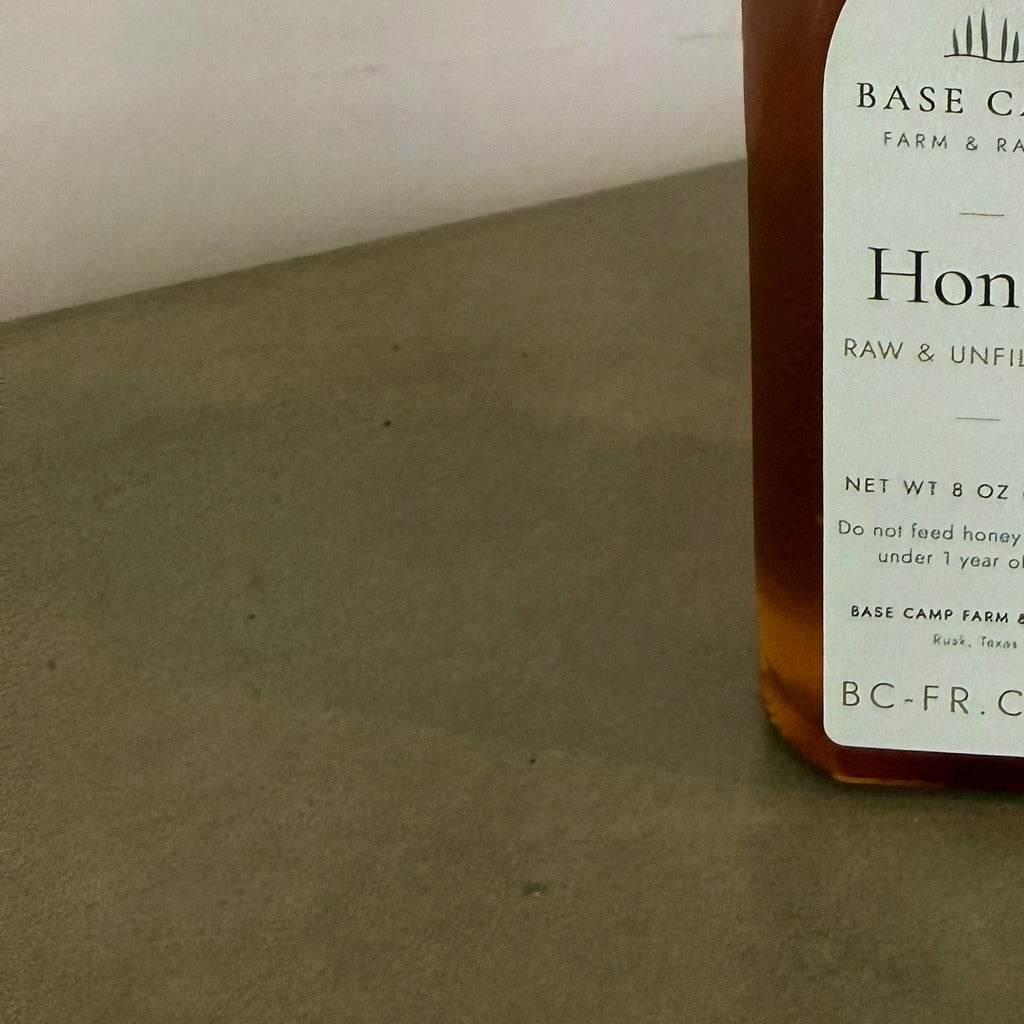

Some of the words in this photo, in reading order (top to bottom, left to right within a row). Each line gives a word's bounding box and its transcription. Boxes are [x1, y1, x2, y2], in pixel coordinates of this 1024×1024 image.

[856, 82, 963, 114] BASE
[883, 131, 948, 150] FARM
[965, 135, 979, 151] &
[843, 337, 904, 360] RAW
[917, 342, 935, 363] &
[845, 476, 890, 494] NET
[903, 479, 938, 496] WT
[951, 482, 963, 498] 8
[976, 483, 1009, 500] OZ
[838, 519, 865, 537] Do
[872, 525, 903, 539] not
[911, 522, 954, 541] feed
[962, 525, 1022, 548] honey
[878, 547, 934, 565] under
[943, 550, 950, 566] 1
[959, 554, 1000, 570] year
[850, 605, 895, 619] BASE
[902, 607, 954, 621] CAMP
[961, 609, 1009, 624] FARM
[932, 633, 972, 649] Rusk,
[981, 635, 1018, 650] Texas
